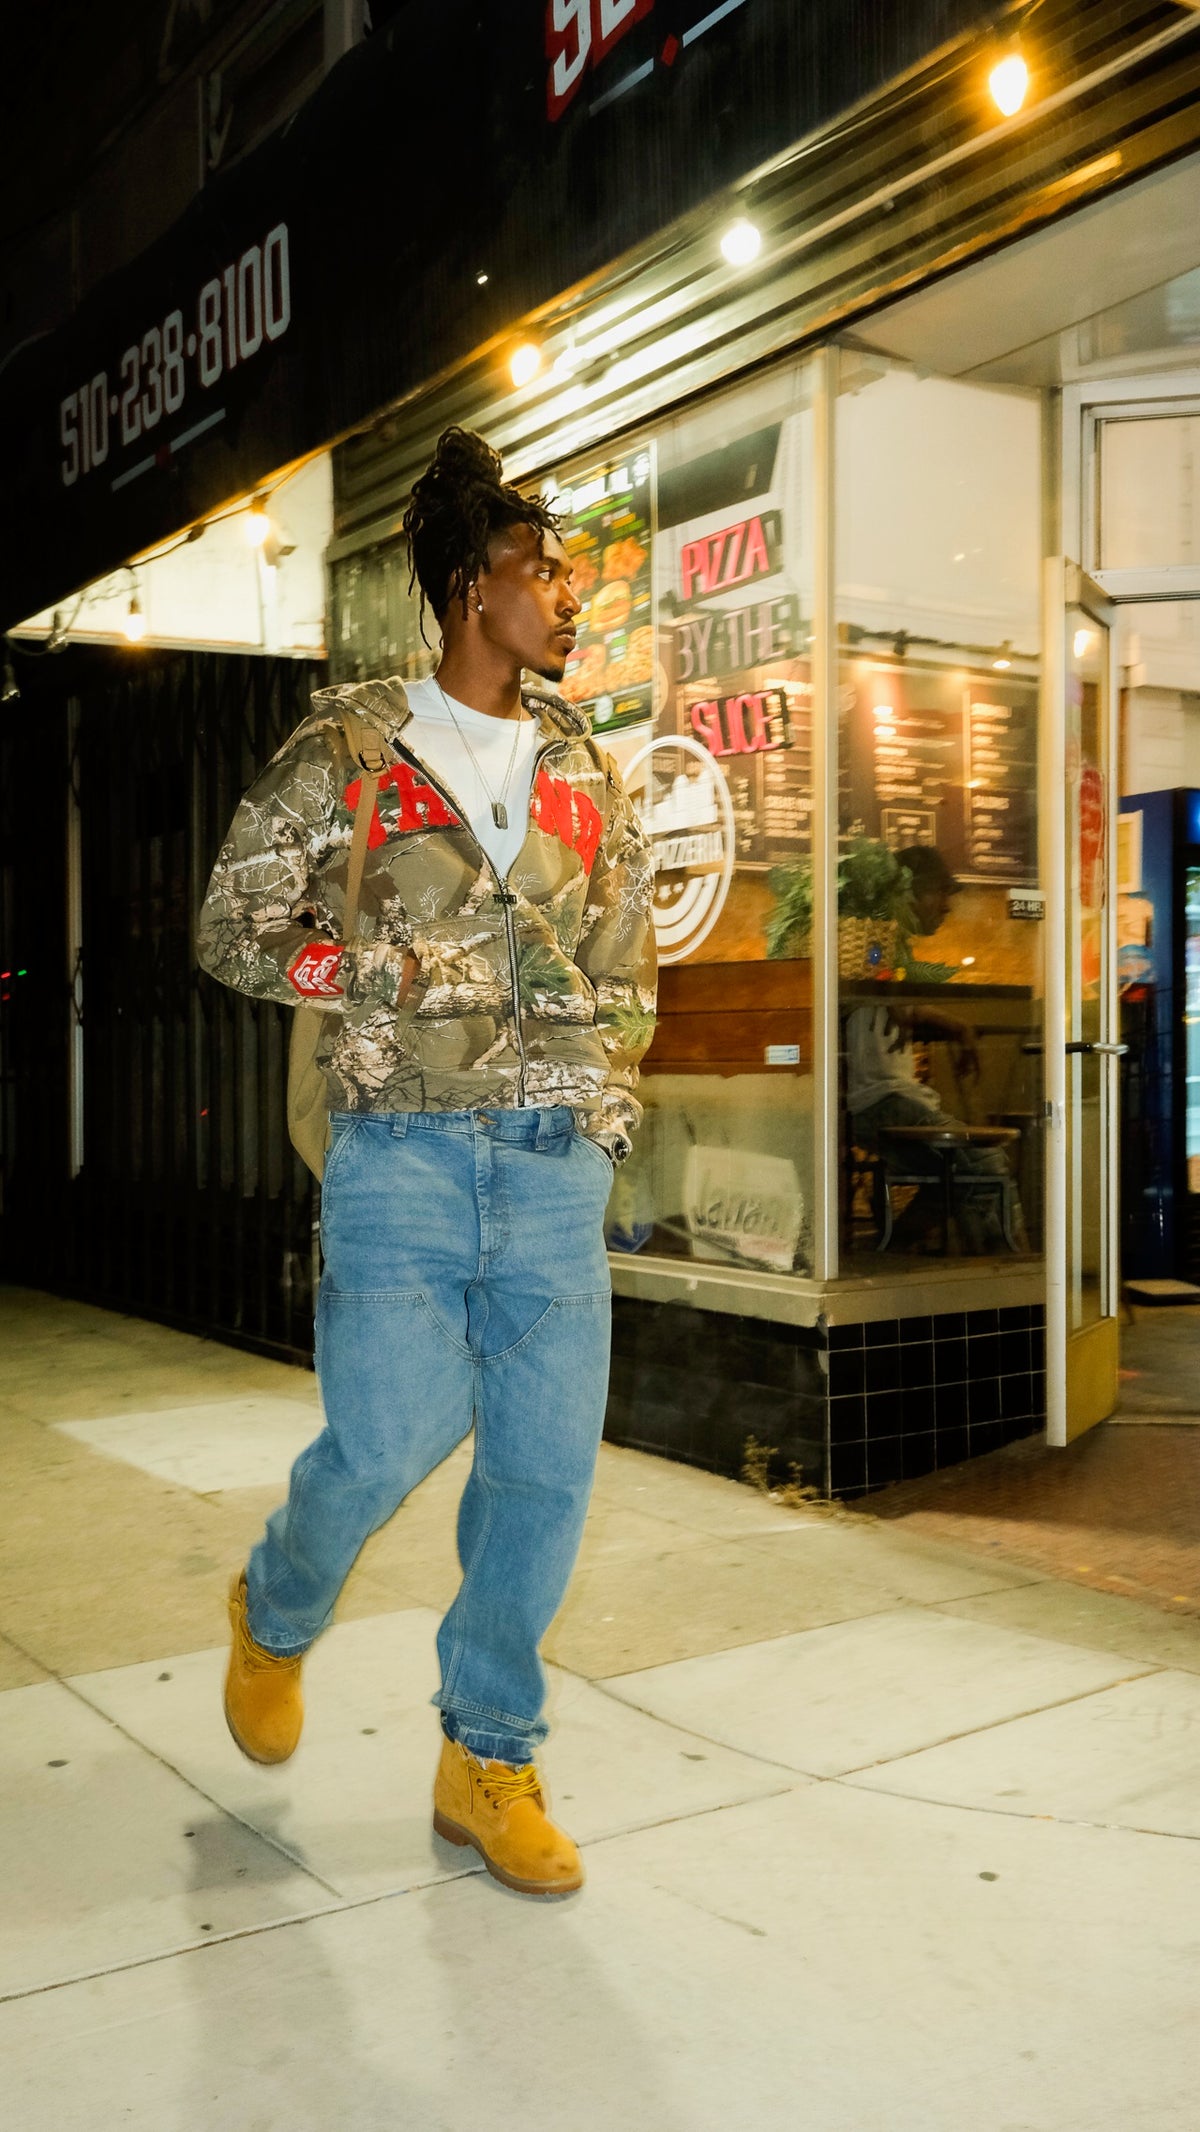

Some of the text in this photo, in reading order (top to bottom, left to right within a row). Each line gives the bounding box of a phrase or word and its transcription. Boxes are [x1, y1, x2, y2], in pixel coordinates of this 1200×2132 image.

[681, 515, 769, 600] PIZZA
[674, 614, 714, 680] BY
[722, 599, 787, 668] THE
[691, 690, 780, 757] SLICE
